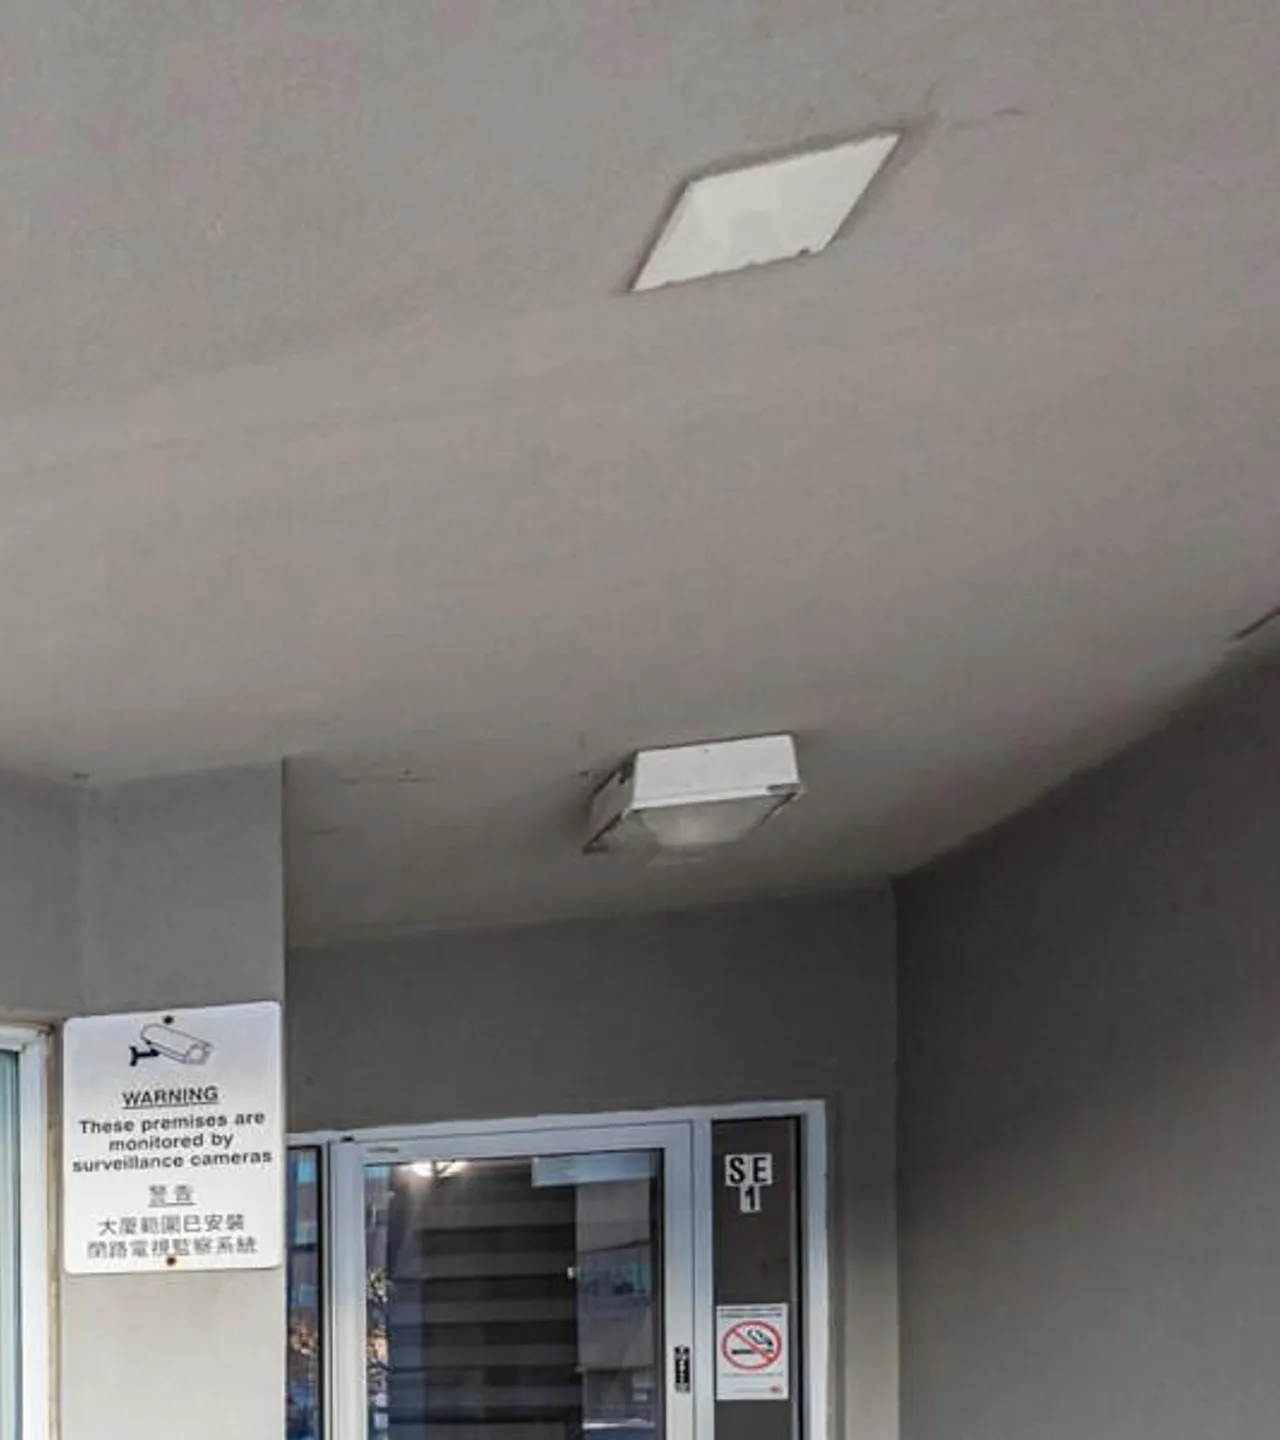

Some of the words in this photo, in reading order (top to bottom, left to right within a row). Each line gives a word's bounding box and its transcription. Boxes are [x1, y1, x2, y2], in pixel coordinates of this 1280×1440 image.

[122, 1086, 219, 1105] WARNING
[79, 1119, 135, 1134] These
[142, 1115, 228, 1135] premises
[235, 1112, 265, 1125] are
[109, 1133, 204, 1152] monitored
[212, 1132, 234, 1149] by
[72, 1152, 184, 1172] surveillance
[190, 1149, 273, 1167] cameras
[729, 1156, 768, 1184] SE
[744, 1187, 756, 1211] 1
